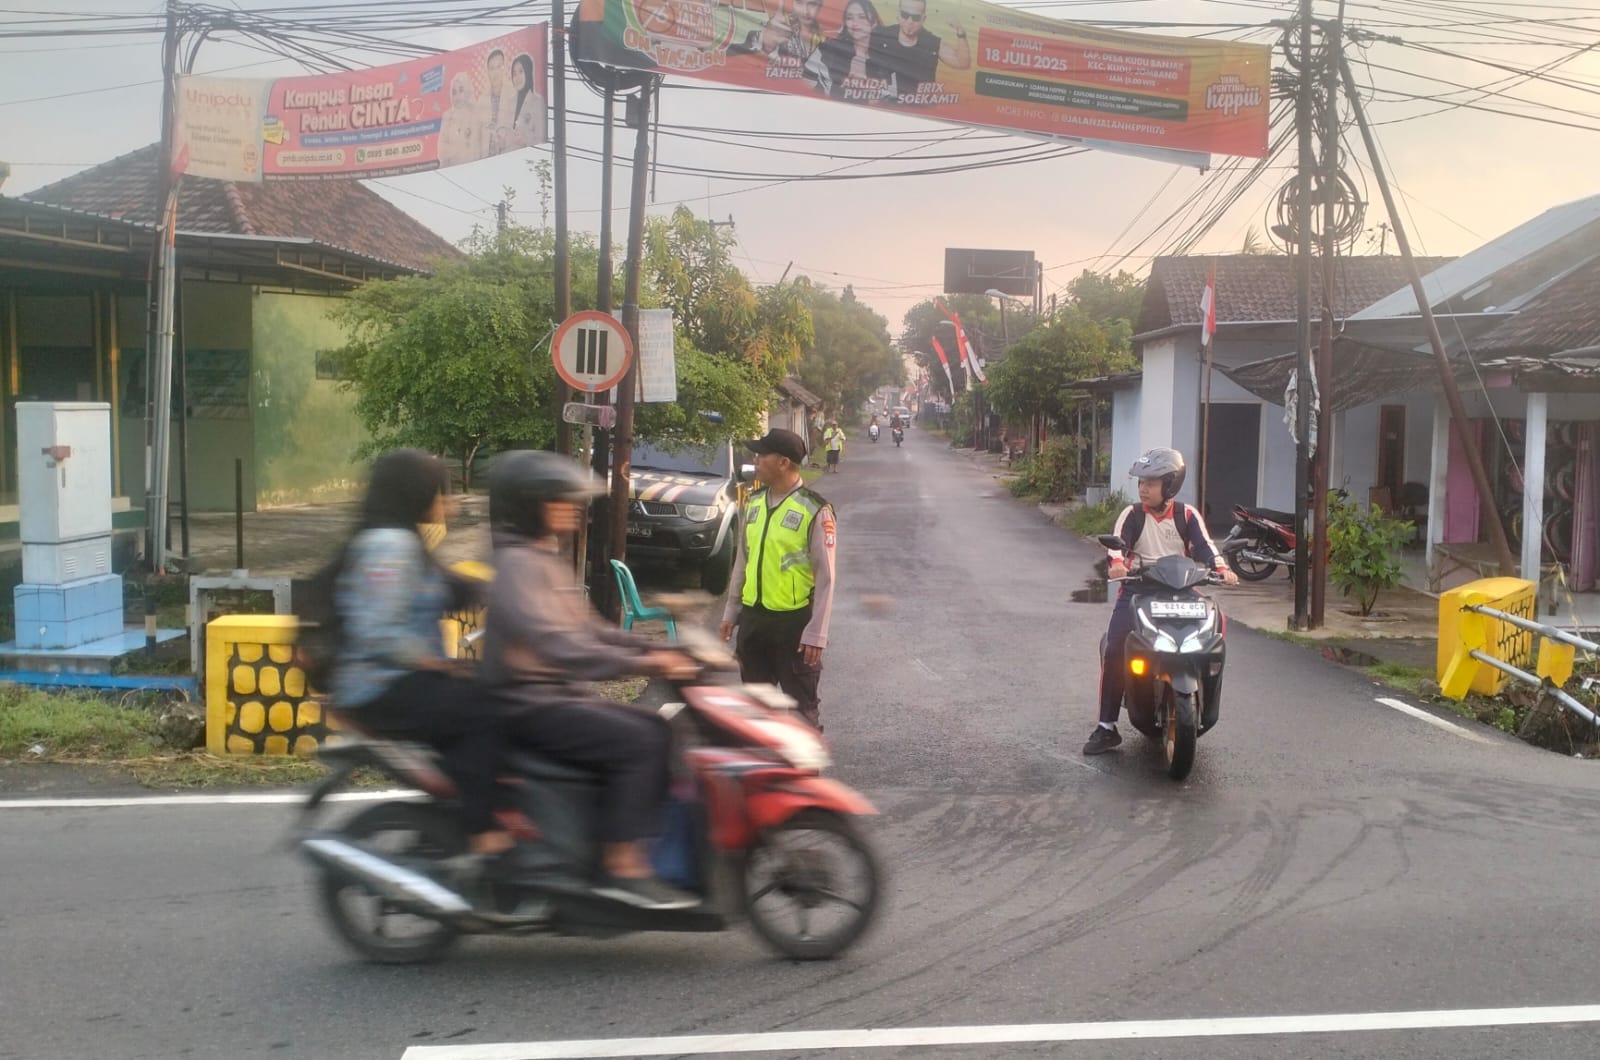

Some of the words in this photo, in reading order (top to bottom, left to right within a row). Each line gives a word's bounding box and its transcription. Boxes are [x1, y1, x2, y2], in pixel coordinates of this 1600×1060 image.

[624, 27, 651, 50] ON
[1011, 38, 1044, 51] JUMAT
[985, 48, 1000, 61] 18
[1003, 51, 1031, 66] JULI
[1034, 55, 1067, 71] 2025
[1102, 53, 1123, 63] DESA
[1125, 56, 1149, 66] KUDU
[765, 67, 803, 79] TAHER
[841, 77, 888, 90] ARLIDA
[917, 82, 945, 94] ERIX
[186, 88, 251, 108] Unipdu
[284, 89, 346, 112] Kampus
[350, 82, 394, 104] Insan
[844, 88, 882, 100] PUTRI
[897, 93, 959, 105] SOEKAMTI
[300, 110, 347, 133] Penuh
[350, 98, 411, 131] CINTA
